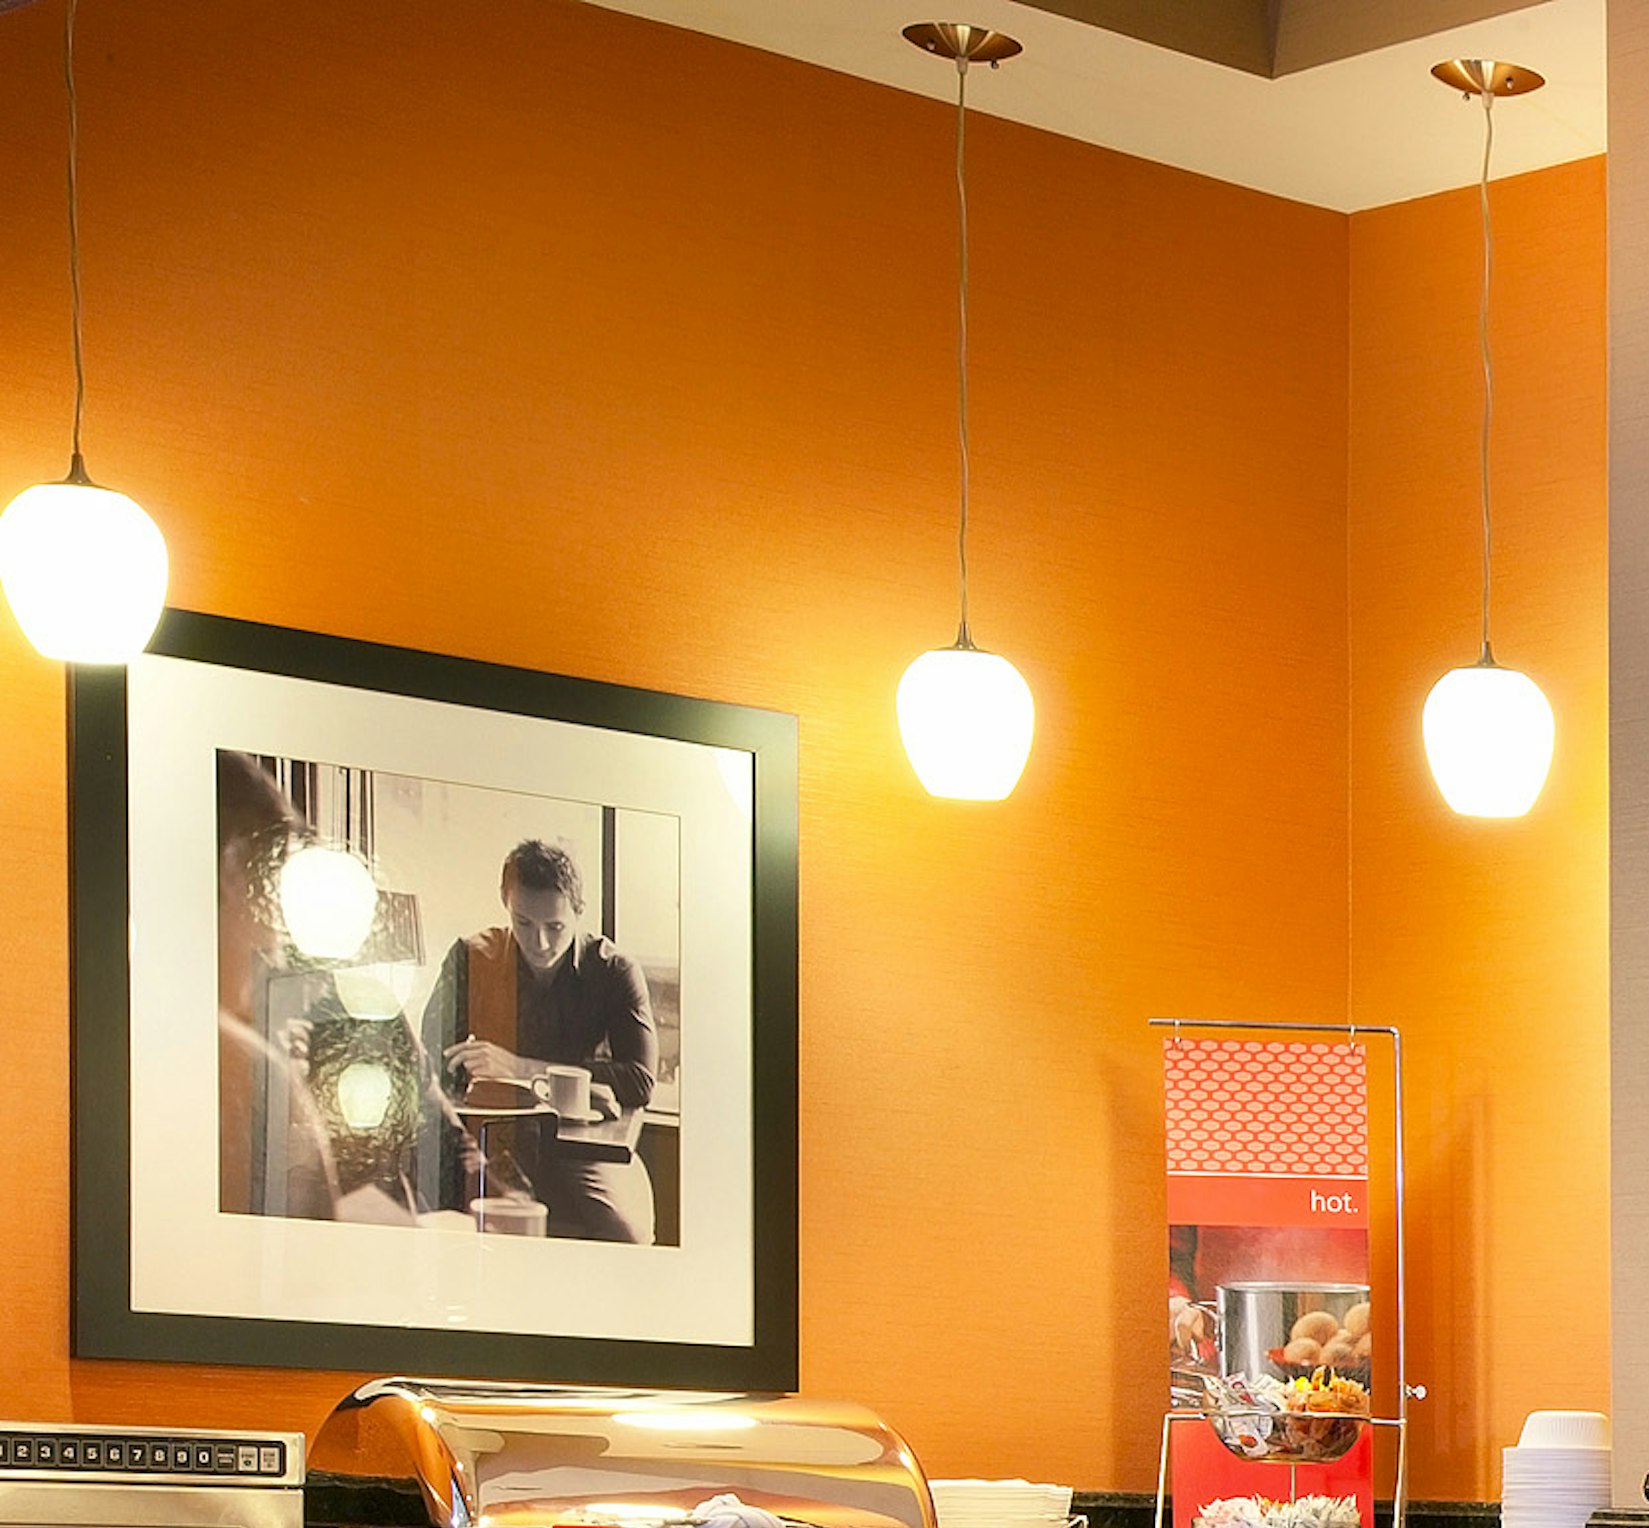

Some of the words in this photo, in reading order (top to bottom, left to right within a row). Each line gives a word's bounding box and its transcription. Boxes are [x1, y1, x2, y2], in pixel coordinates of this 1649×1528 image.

[1310, 1188, 1360, 1214] hot.
[17, 1445, 29, 1458] 2
[40, 1445, 51, 1458] 3
[63, 1446, 75, 1458] 4
[86, 1446, 97, 1460] 5
[109, 1447, 120, 1460] 6
[132, 1448, 143, 1461] 7
[154, 1449, 165, 1462] 8
[177, 1450, 187, 1463] 9
[198, 1451, 209, 1464] 0
